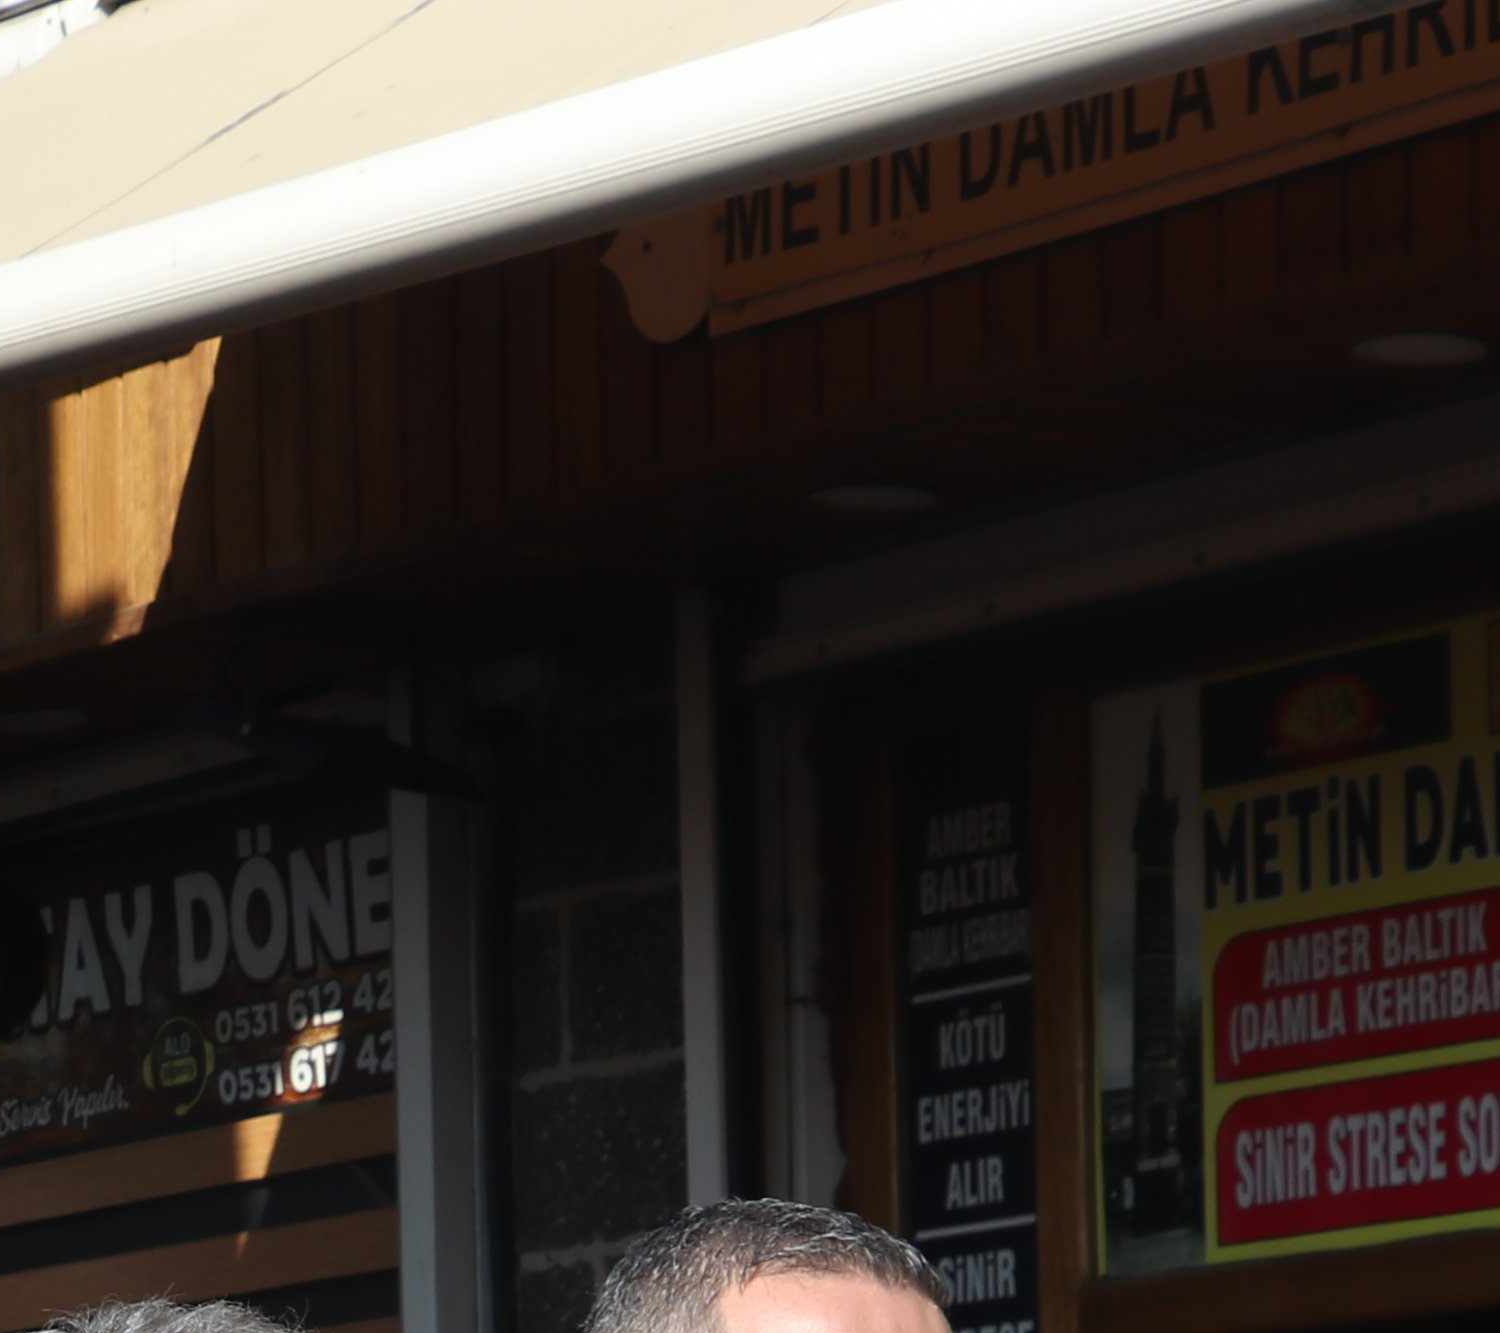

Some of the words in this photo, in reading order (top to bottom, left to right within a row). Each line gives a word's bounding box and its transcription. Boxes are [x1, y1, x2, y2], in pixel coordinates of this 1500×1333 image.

[174, 825, 394, 995] DÖNE
[920, 852, 1019, 916] BALTIK
[1261, 923, 1371, 990] AMBER
[1381, 902, 1488, 969] BALTIK
[215, 1000, 279, 1043] 0531
[286, 980, 345, 1031] 612
[938, 1003, 1006, 1071] KÖTÜ
[1229, 988, 1347, 1067] (DAMLA
[218, 1060, 284, 1105] 0531
[288, 1039, 346, 1094] 617
[1326, 1101, 1448, 1195] STRESE
[945, 1155, 1005, 1212] ALIR
